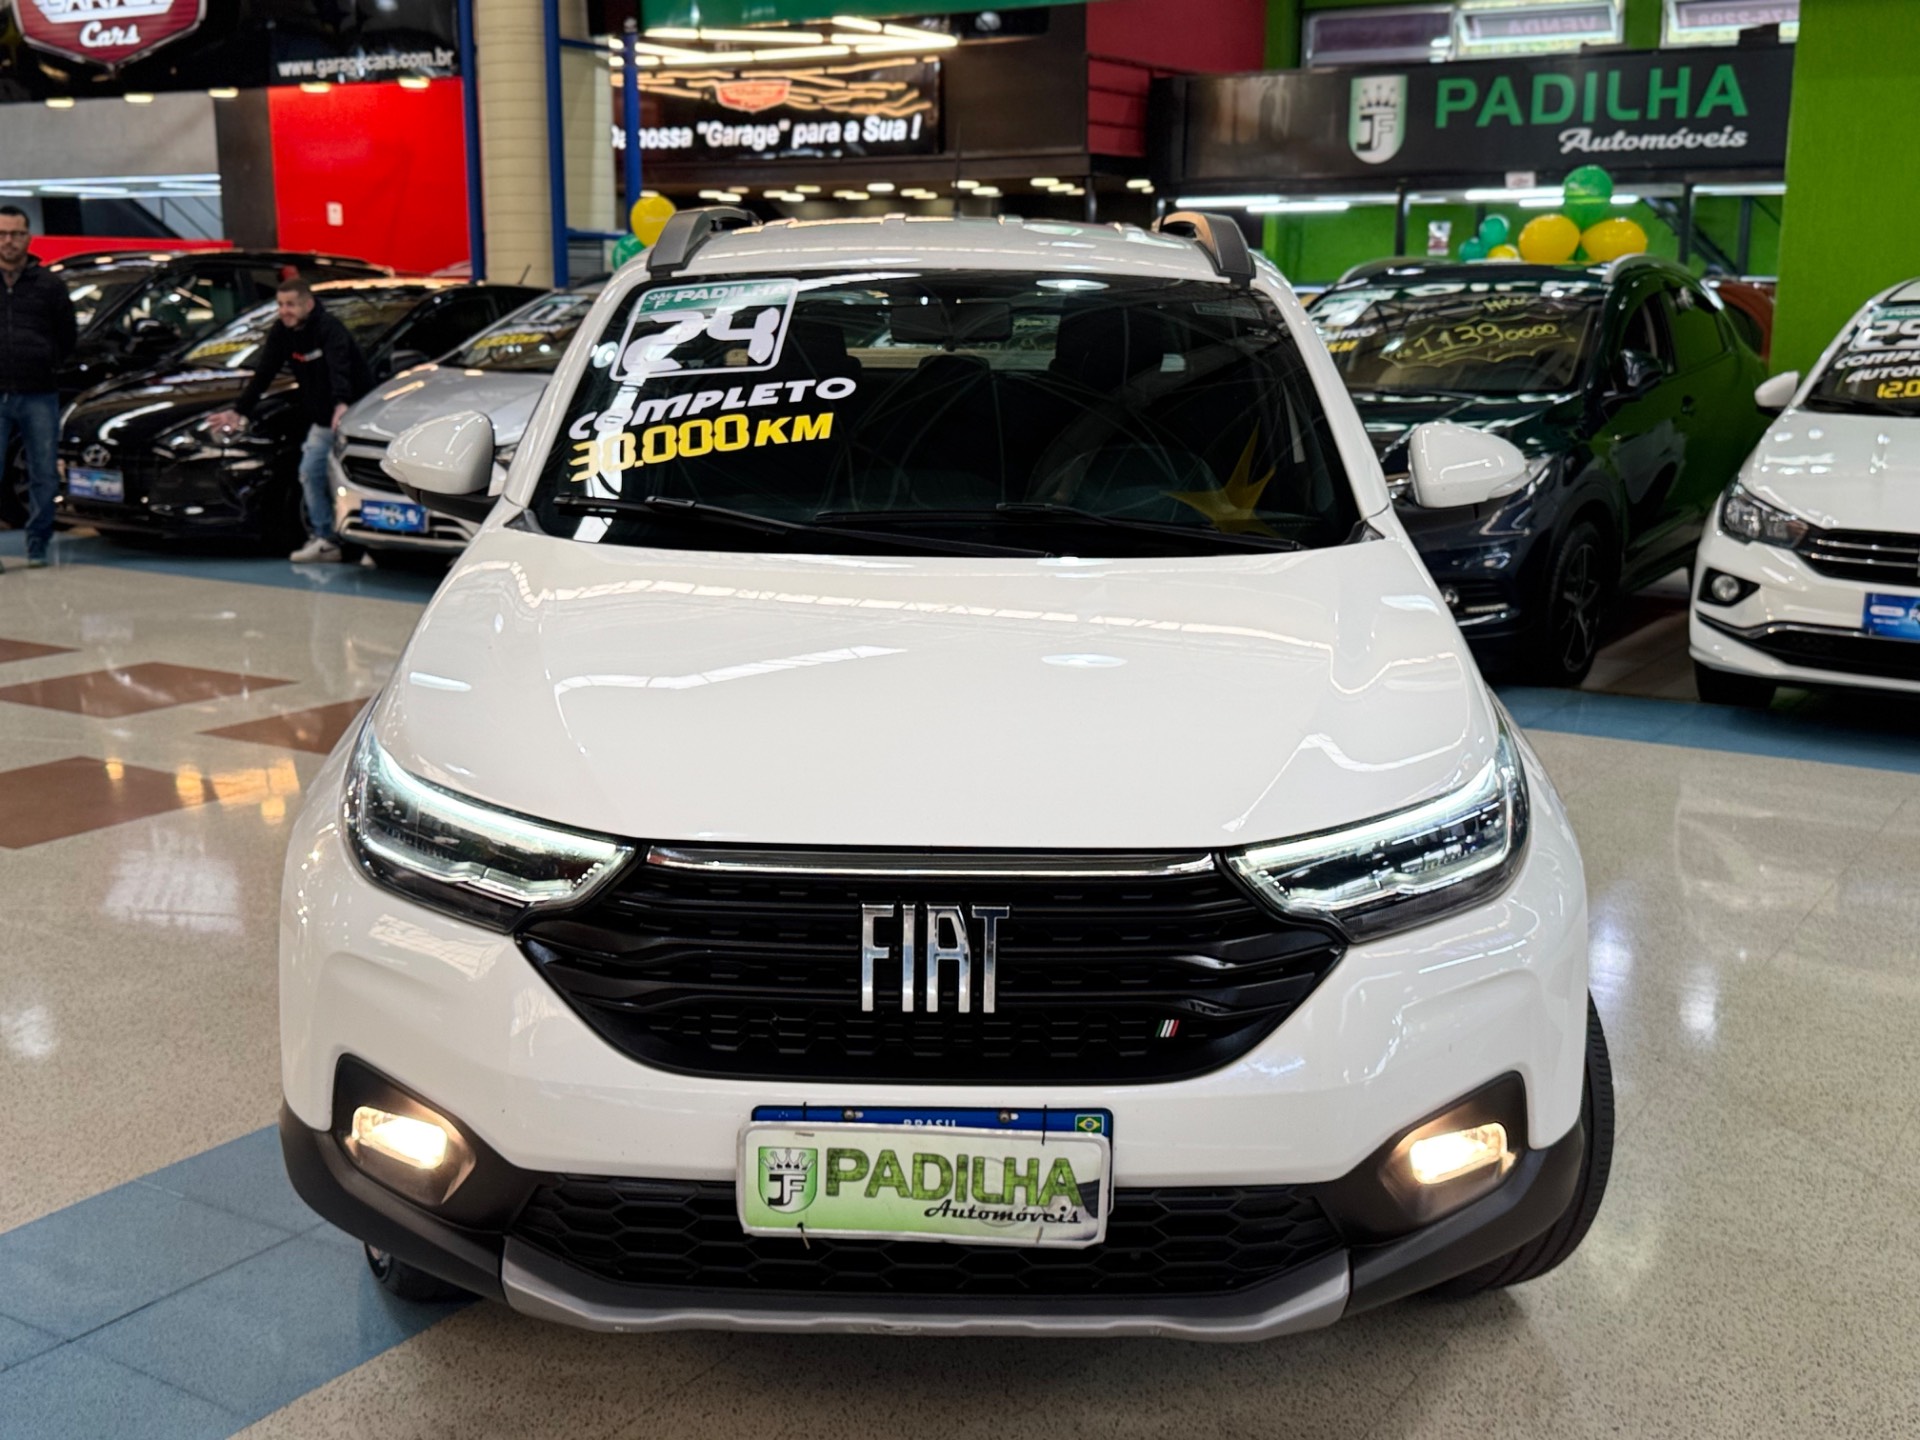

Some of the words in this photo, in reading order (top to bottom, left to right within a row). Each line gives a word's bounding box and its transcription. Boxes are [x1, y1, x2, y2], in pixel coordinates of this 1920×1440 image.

[80, 20, 140, 48] Cars
[1435, 64, 1748, 129] PADILHA
[697, 119, 791, 151] "Garage"
[792, 121, 841, 149] para
[844, 121, 860, 142] a
[863, 115, 907, 142] Sua
[910, 113, 922, 140] !
[1559, 125, 1748, 155] Automóveis
[674, 283, 786, 303] PADILHA
[621, 307, 780, 373] 24
[569, 377, 857, 440] COMPLETO
[569, 414, 750, 482] 30.000
[754, 412, 834, 447] KM
[861, 903, 1010, 1013] FIAT
[767, 1173, 807, 1207] JF
[825, 1147, 1083, 1207] PADILHA
[924, 1198, 1082, 1225] Automóveis
